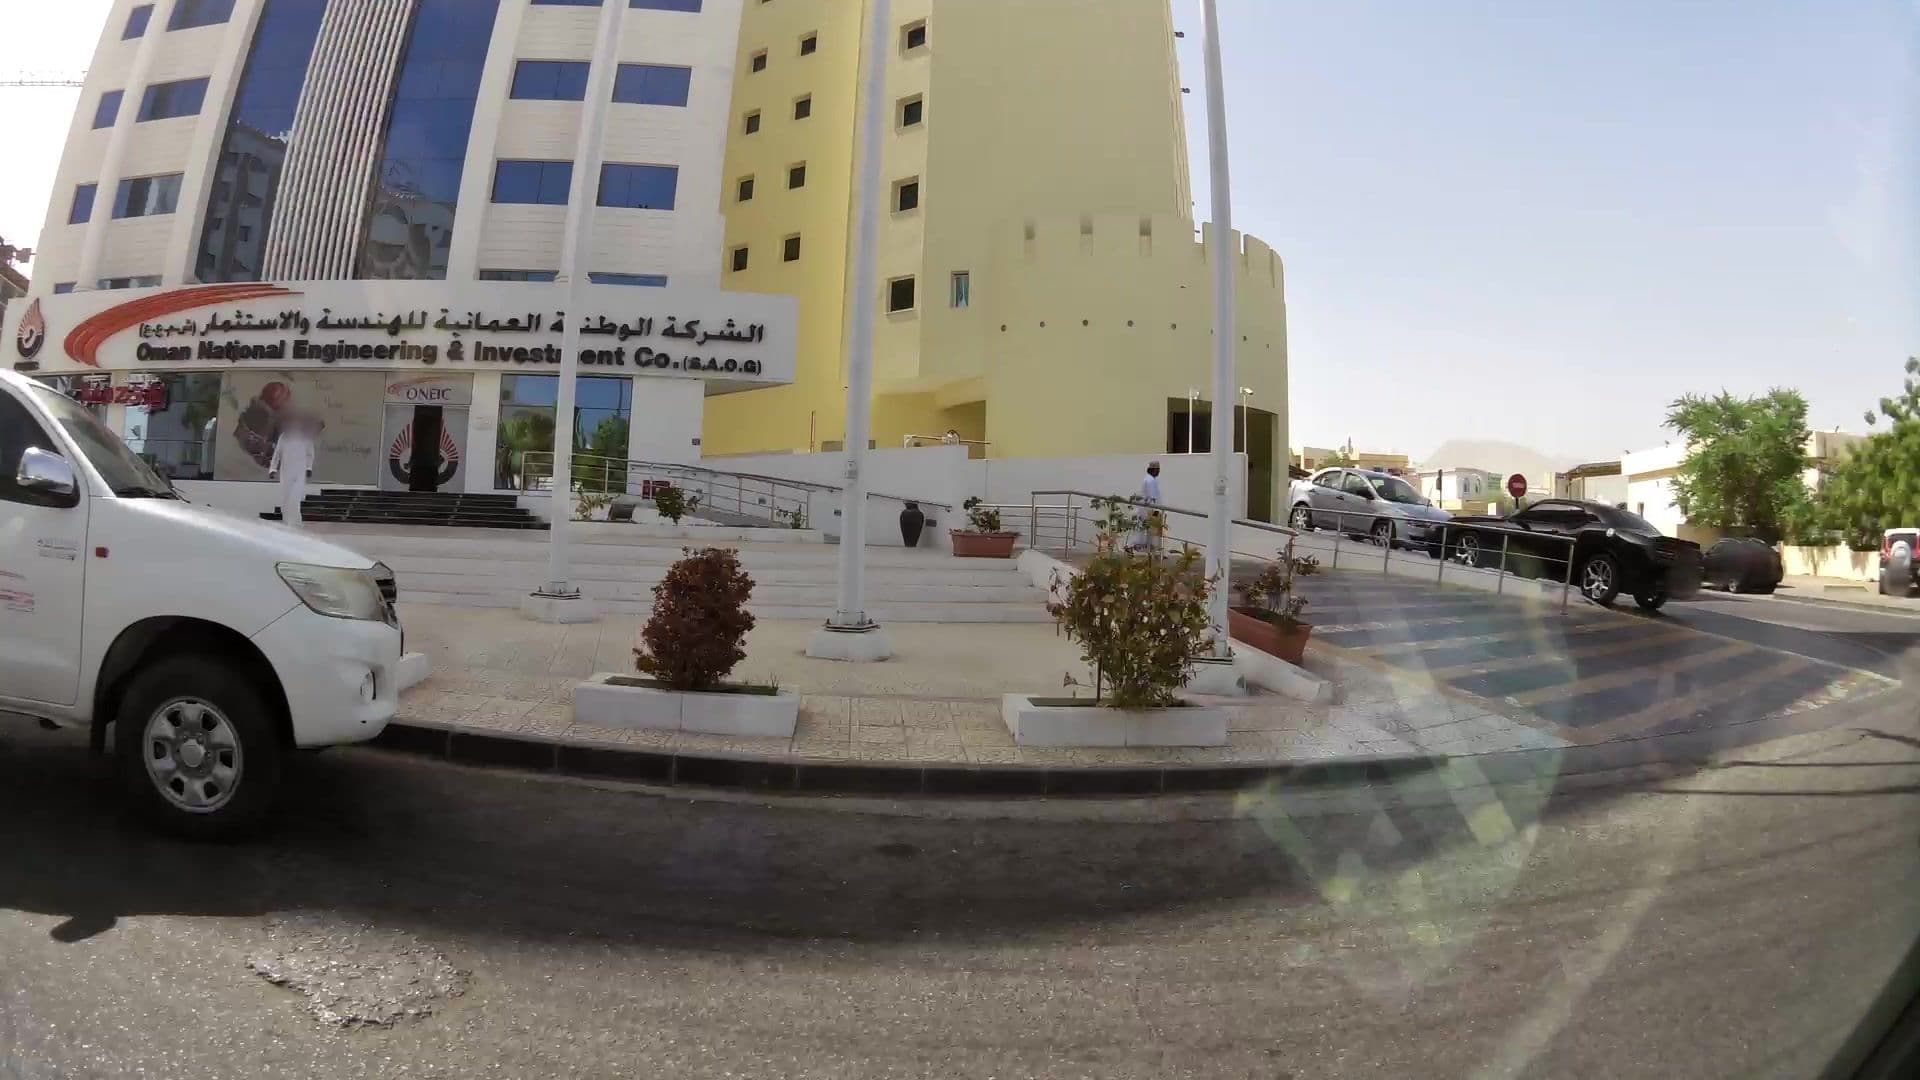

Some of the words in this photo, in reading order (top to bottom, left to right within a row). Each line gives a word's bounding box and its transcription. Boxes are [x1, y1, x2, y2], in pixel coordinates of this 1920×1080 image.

[200, 309, 310, 336] والاستثمار
[316, 308, 428, 336] للهندسة
[433, 308, 541, 333] العمانية
[550, 311, 653, 342] الوطنة
[661, 315, 764, 346] الشركة
[136, 342, 192, 361] Oman
[198, 339, 286, 363] National
[292, 339, 438, 364] Engineering
[446, 340, 464, 361] &
[474, 341, 626, 366] Investent
[634, 346, 680, 369] Co.
[406, 387, 452, 401] ONEIC
